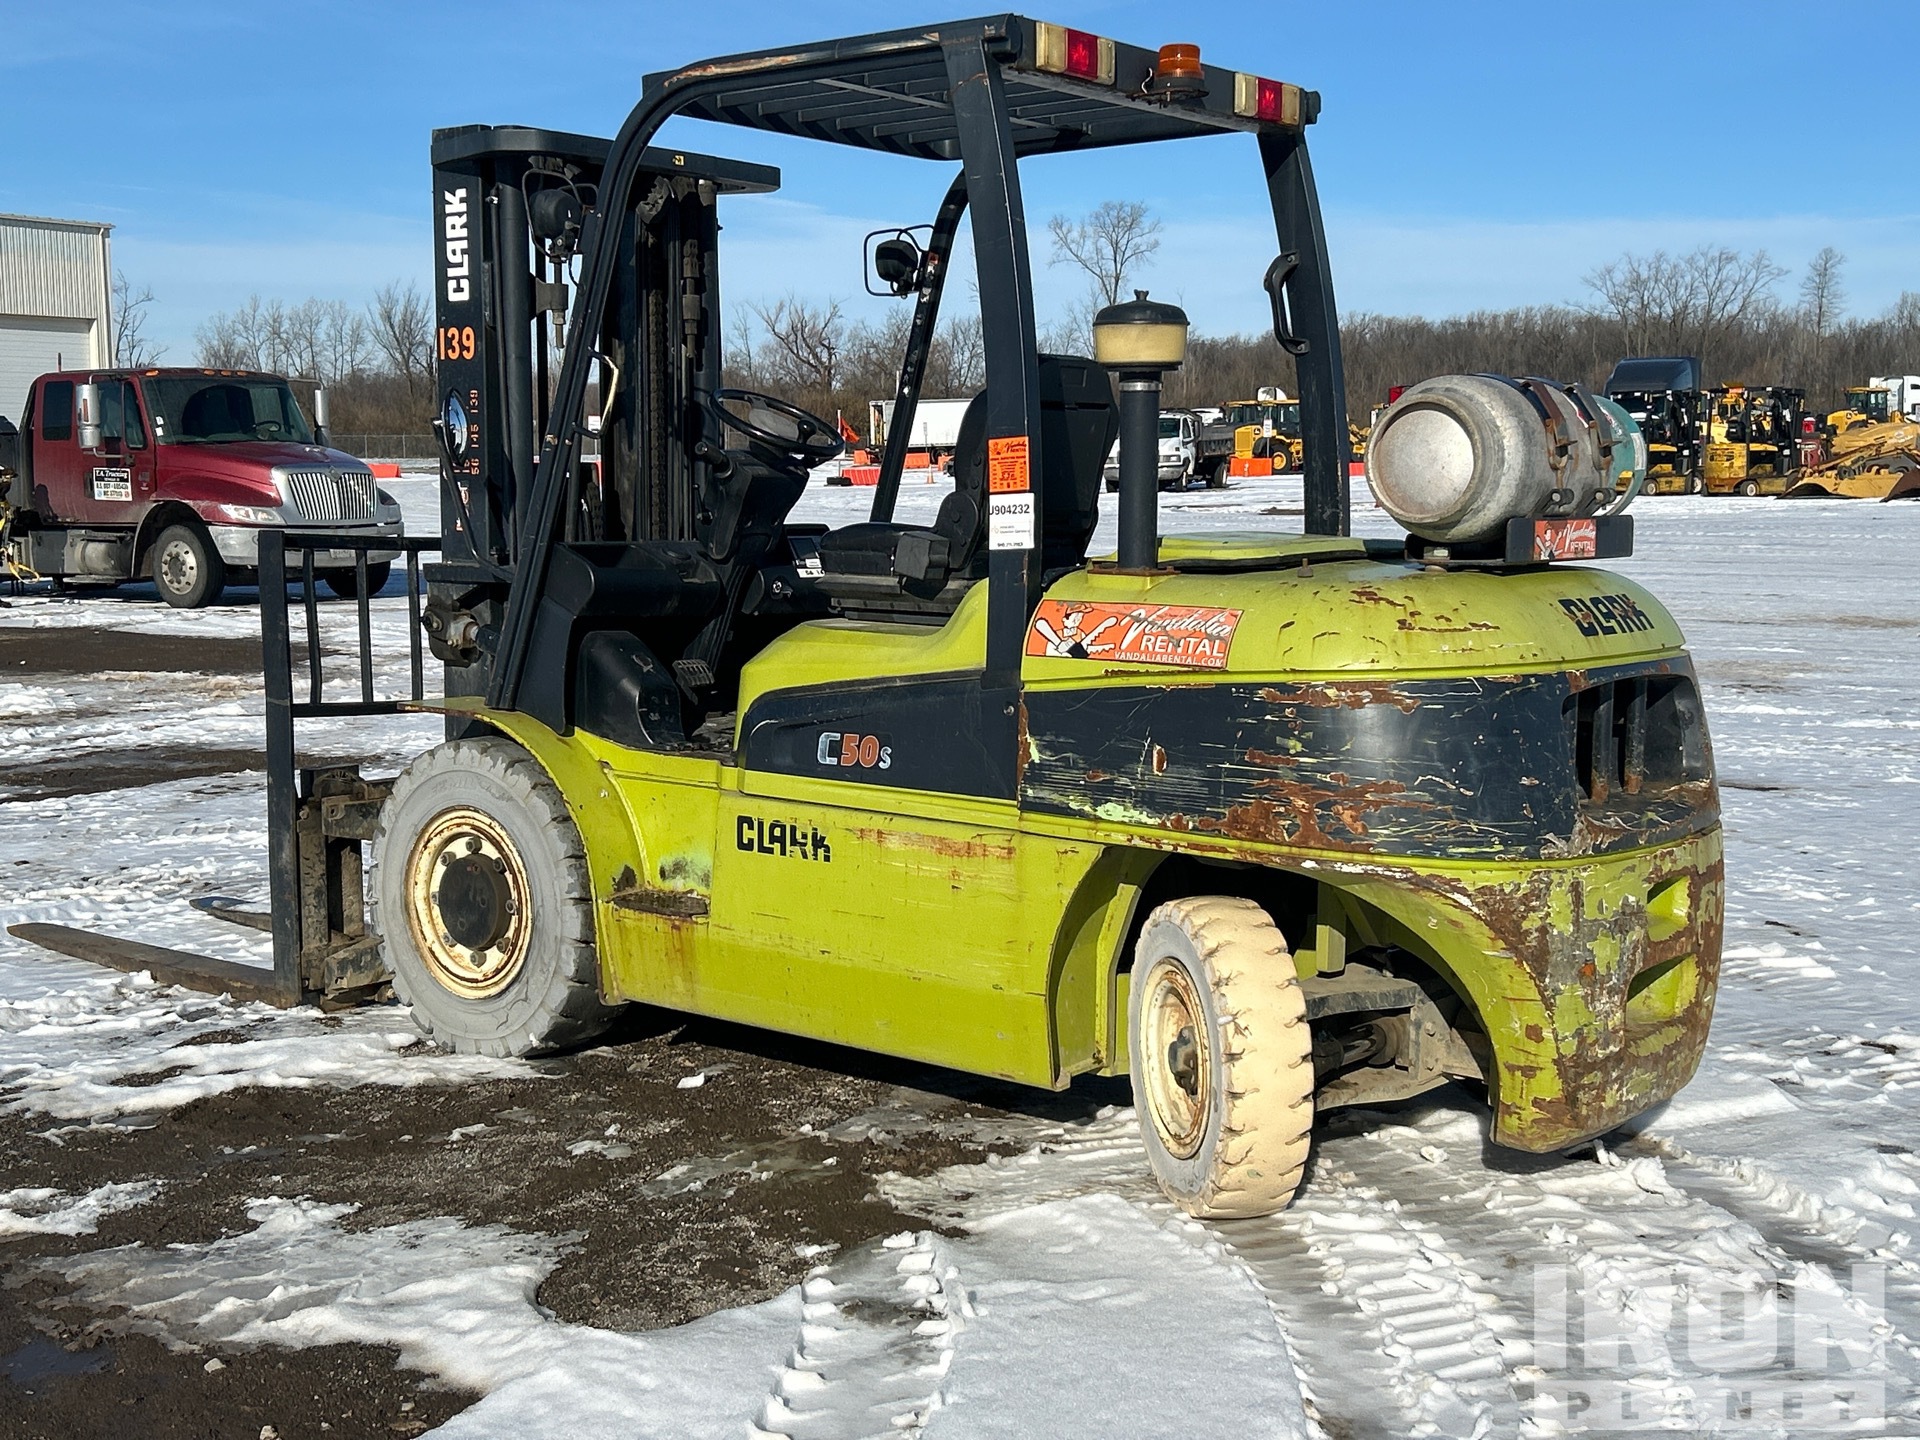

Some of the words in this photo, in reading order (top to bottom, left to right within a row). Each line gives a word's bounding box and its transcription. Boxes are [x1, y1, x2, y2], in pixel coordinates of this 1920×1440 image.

[444, 187, 470, 302] CLARK
[439, 326, 475, 360] 139
[469, 389, 479, 413] 139
[1570, 541, 1596, 553] RENTAL
[1118, 605, 1233, 650] Vandalia
[1558, 594, 1655, 637] CLARK
[1114, 651, 1223, 668] VANDALIARENTAL.COM
[1139, 634, 1226, 658] RENTAL
[736, 814, 832, 863] CLARK
